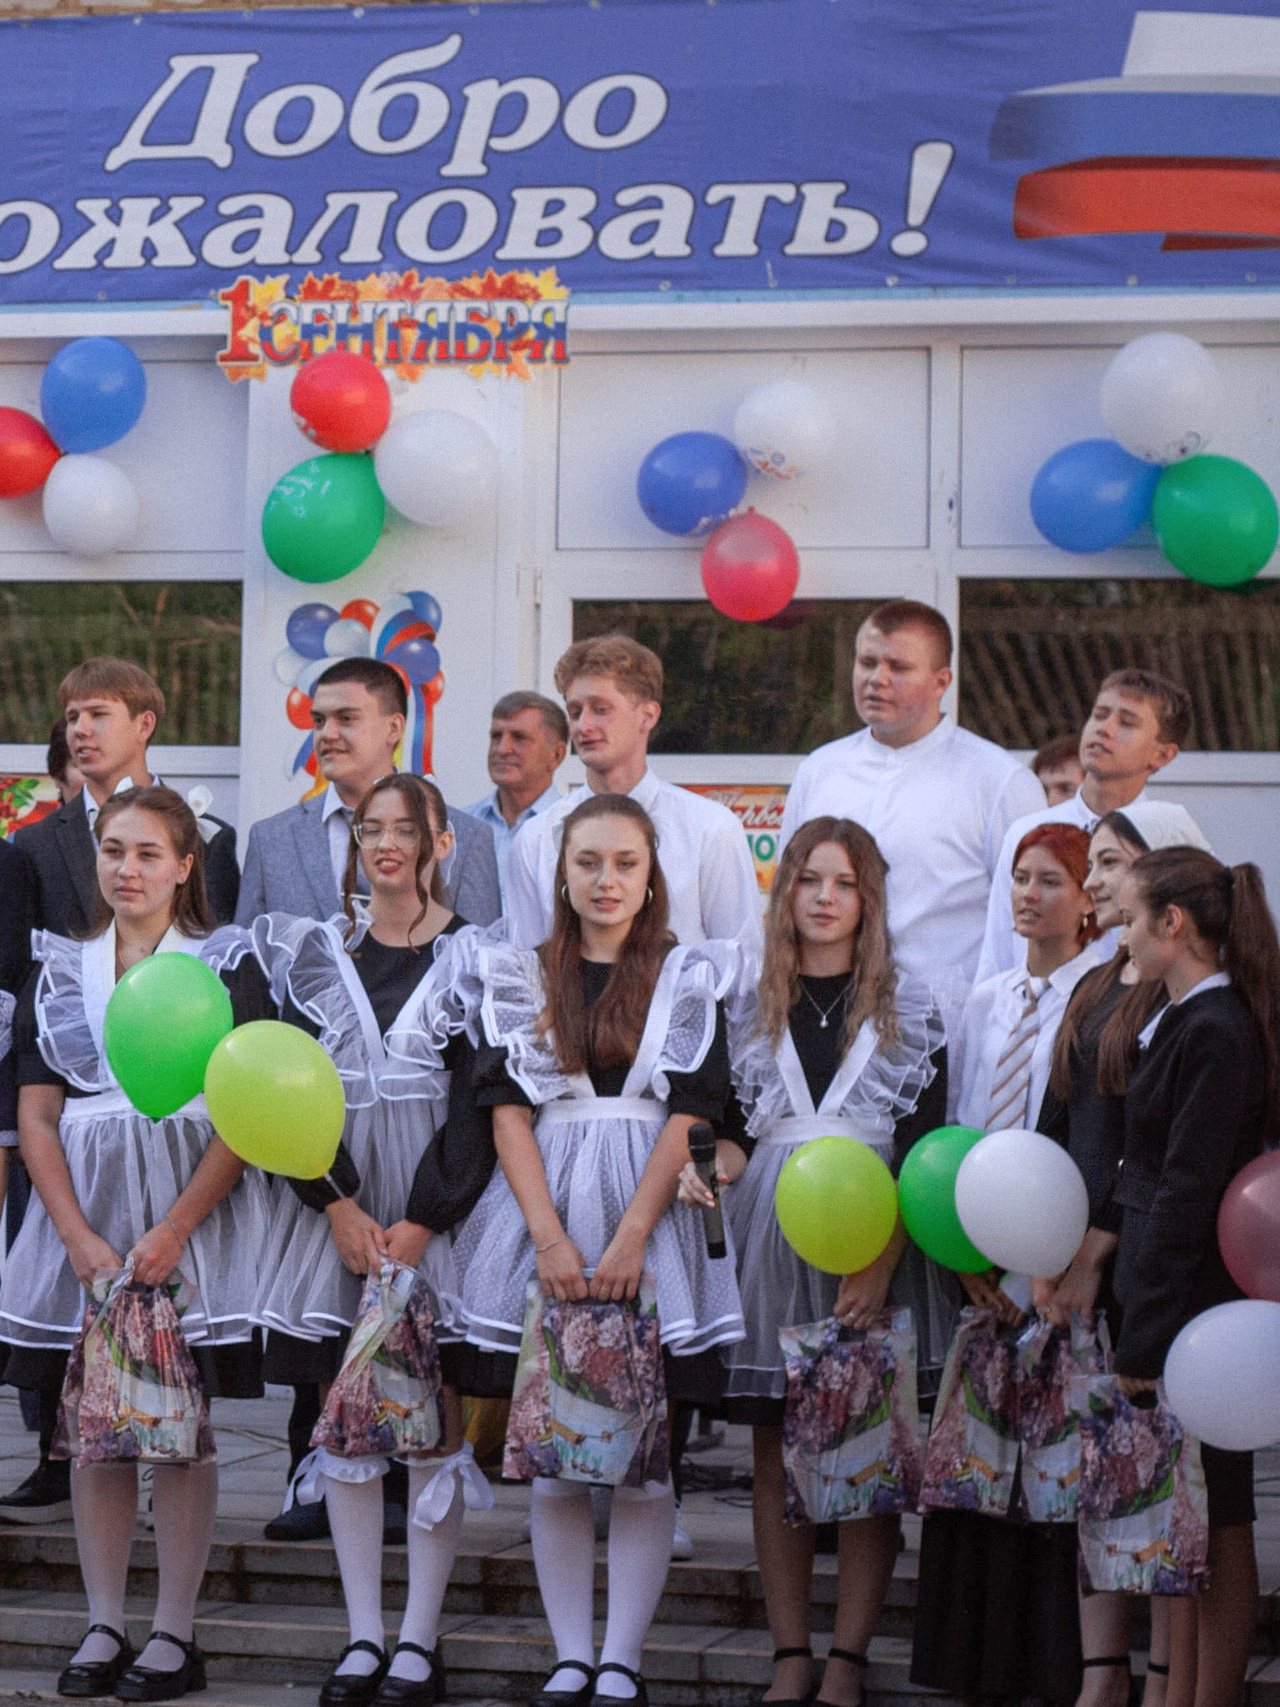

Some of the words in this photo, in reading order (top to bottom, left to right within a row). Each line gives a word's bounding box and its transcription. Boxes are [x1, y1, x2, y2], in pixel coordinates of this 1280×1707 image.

[104, 33, 669, 177] Добро
[218, 276, 261, 364] 1
[259, 300, 570, 365] СЕНТЯБРЯ
